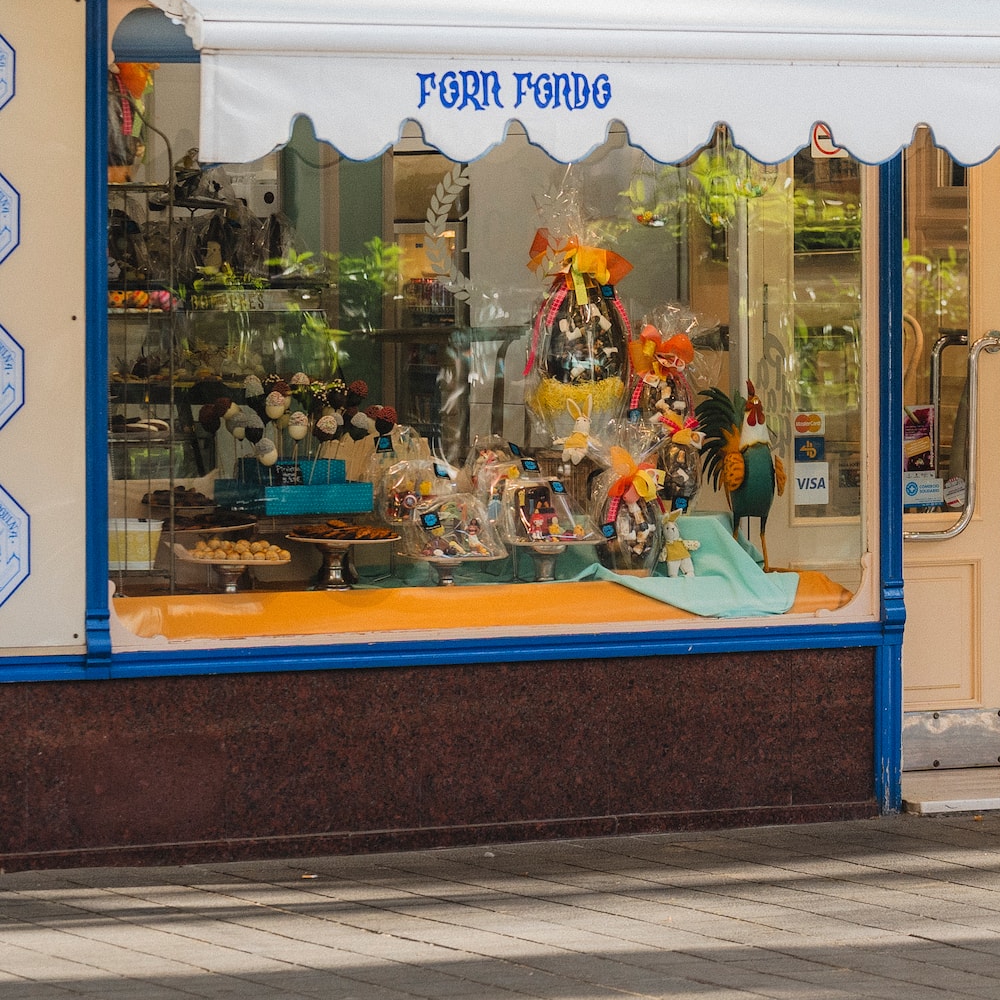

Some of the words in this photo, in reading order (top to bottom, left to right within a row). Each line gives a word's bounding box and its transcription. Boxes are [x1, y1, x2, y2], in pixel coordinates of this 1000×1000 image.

[415, 70, 505, 112] FORN
[512, 71, 613, 112] FONDO
[796, 477, 826, 491] VISA
